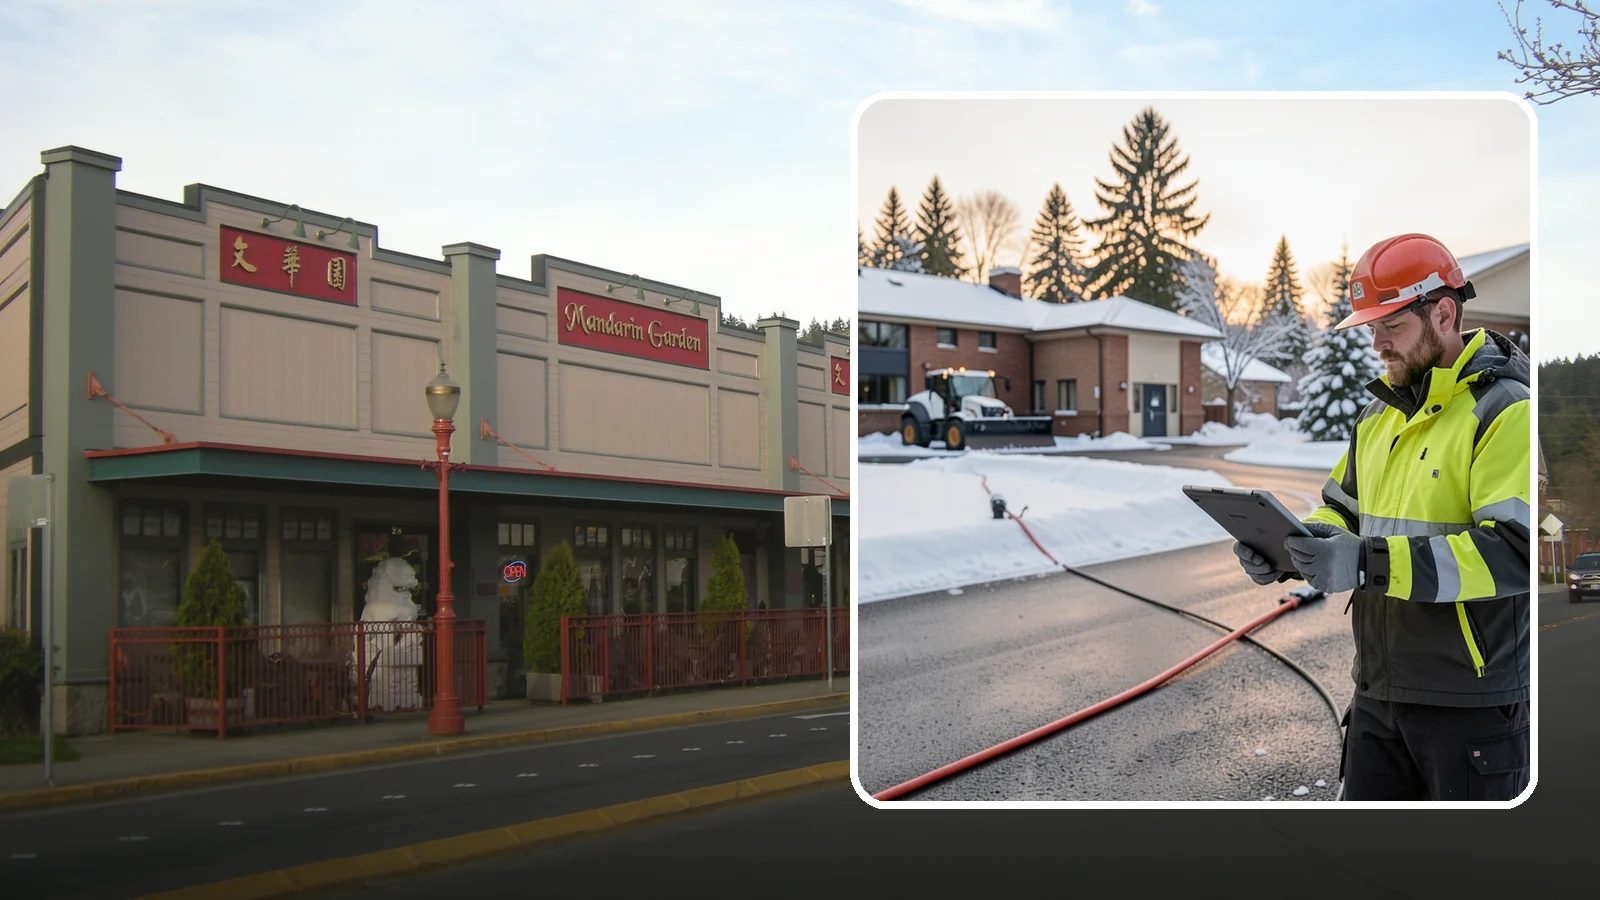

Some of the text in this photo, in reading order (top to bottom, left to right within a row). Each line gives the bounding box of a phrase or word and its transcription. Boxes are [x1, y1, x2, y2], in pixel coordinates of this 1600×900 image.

[231, 236, 346, 290] 文華園
[565, 302, 702, 352] Mandarin Garden
[835, 363, 846, 386] 文
[503, 565, 527, 578] OPEN
